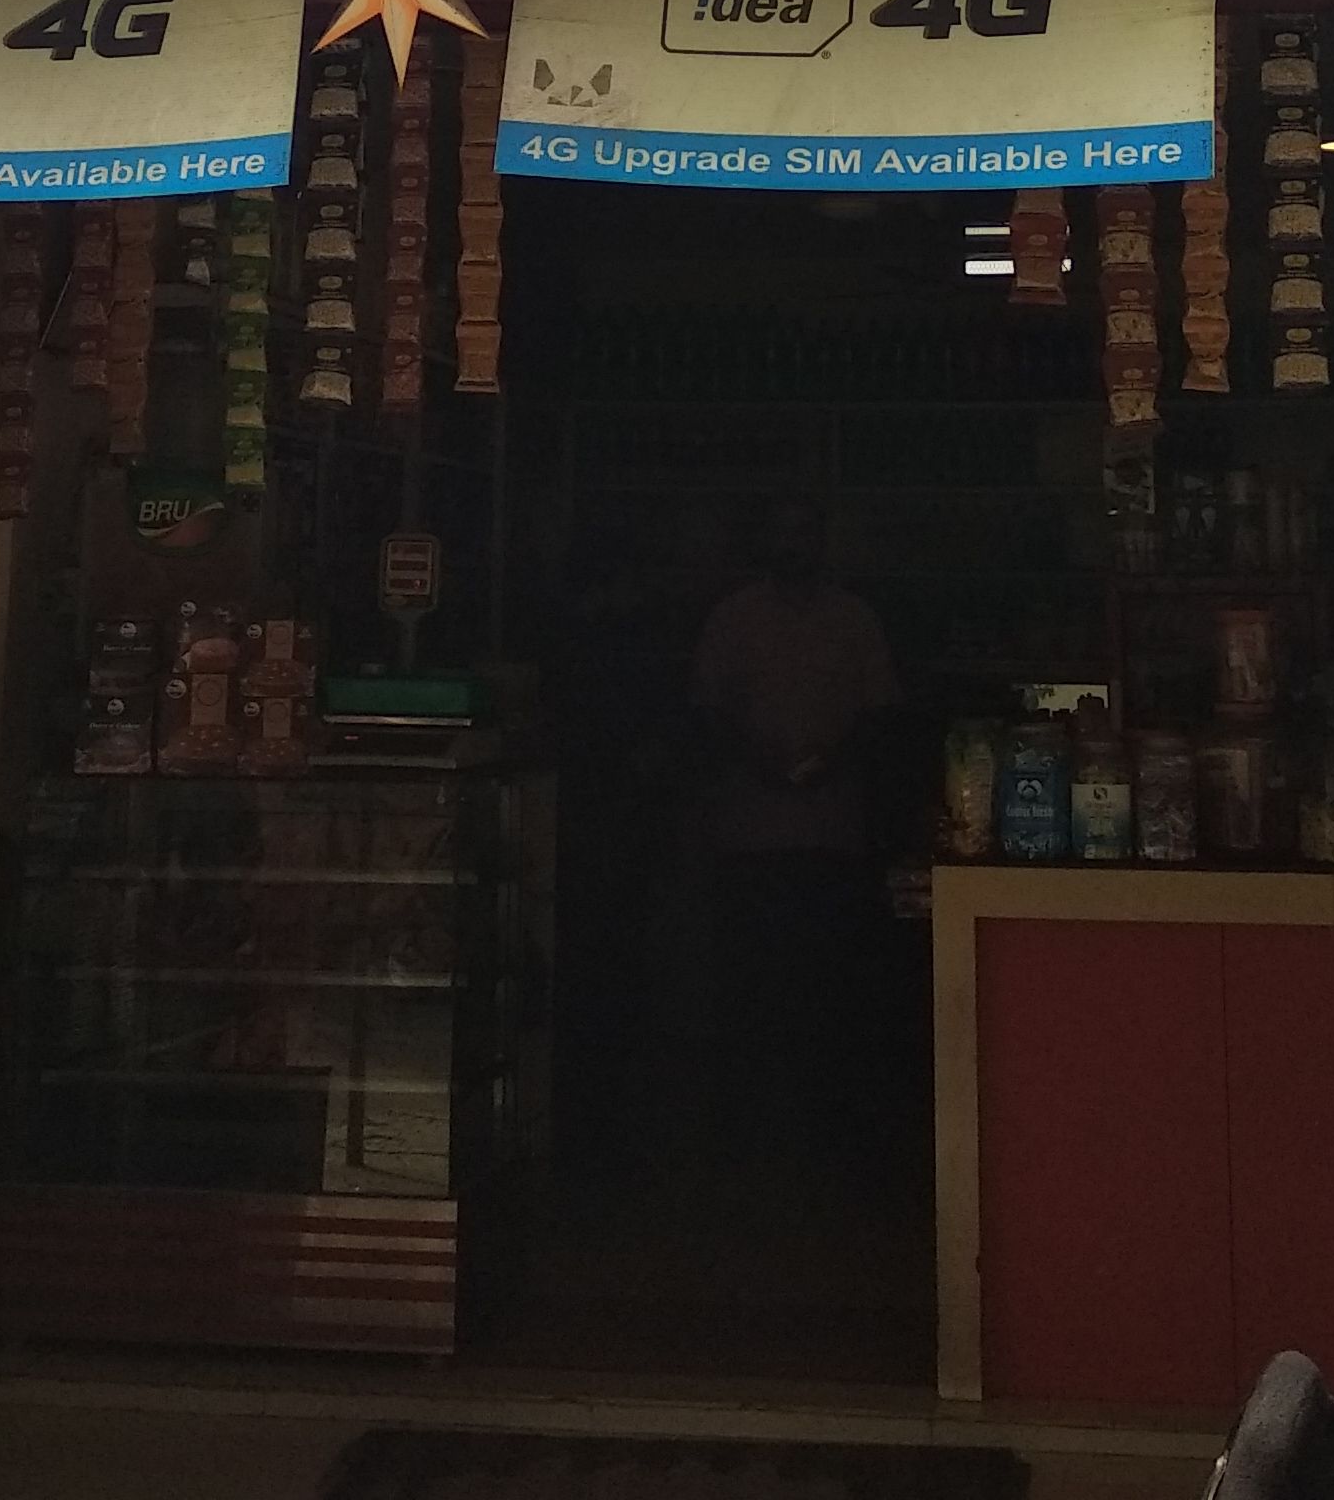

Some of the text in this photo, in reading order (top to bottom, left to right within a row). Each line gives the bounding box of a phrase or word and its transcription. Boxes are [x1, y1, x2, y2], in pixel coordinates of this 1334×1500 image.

[179, 151, 267, 179] Here
[519, 137, 1182, 177] 4G Upgrade SIM Available Here
[138, 500, 191, 523] BRU
